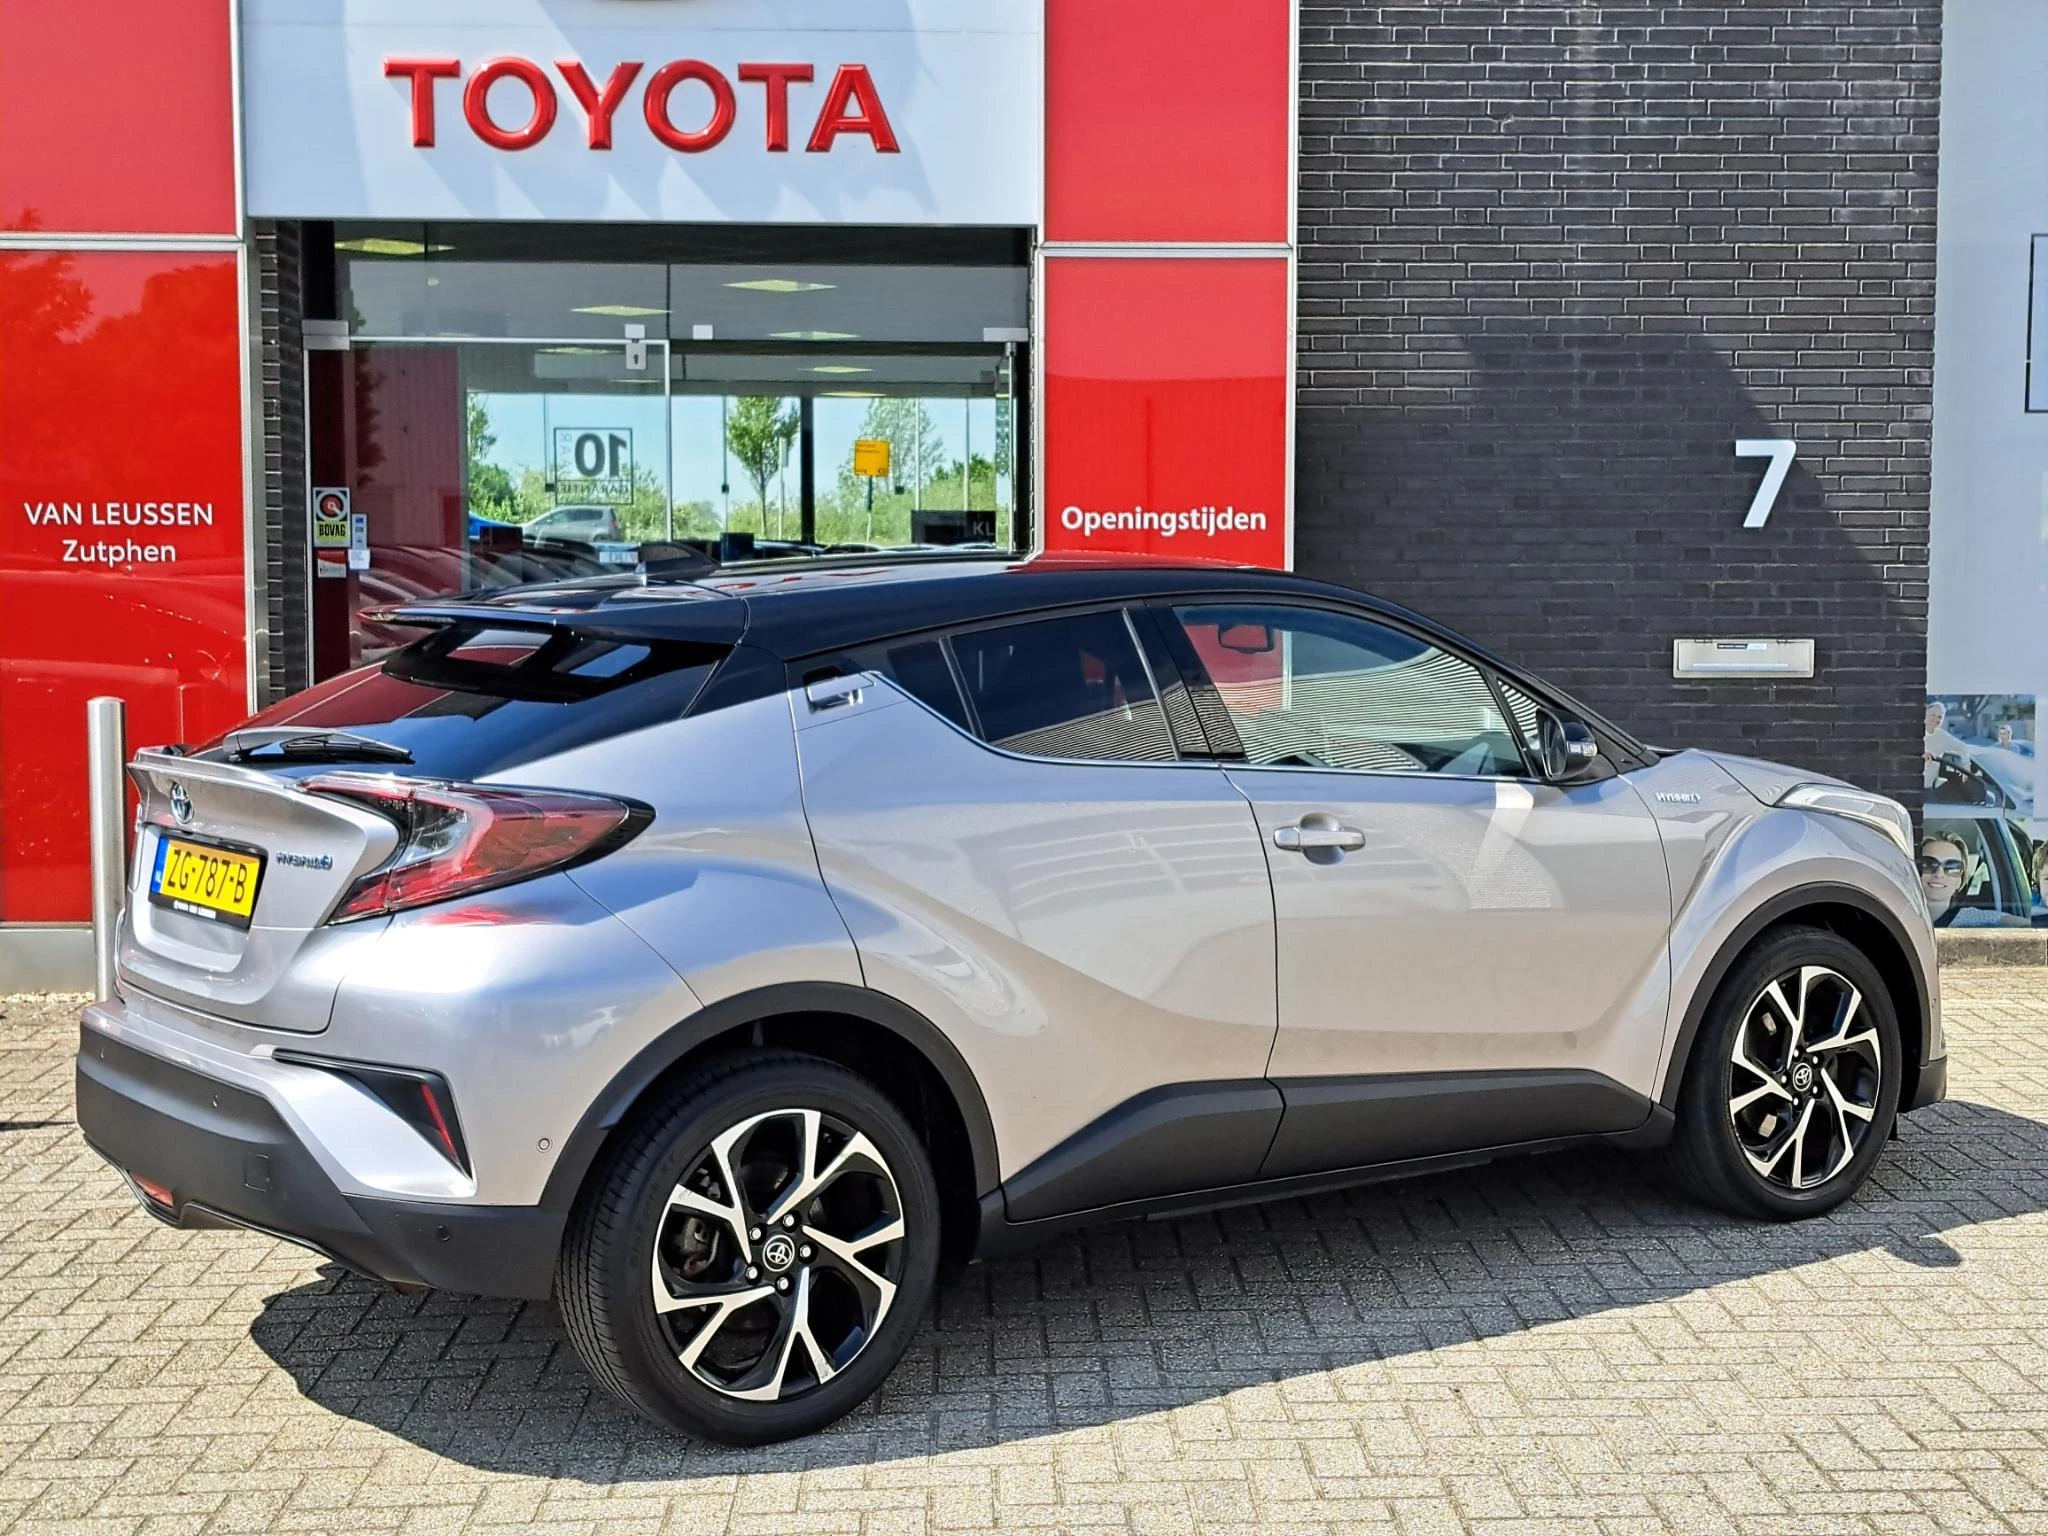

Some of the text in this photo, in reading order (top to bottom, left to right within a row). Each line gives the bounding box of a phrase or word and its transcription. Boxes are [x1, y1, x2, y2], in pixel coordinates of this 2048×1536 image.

[384, 56, 901, 153] TOYOTA
[1735, 439, 1797, 528] 7
[24, 502, 213, 526] VAN LEUSSEN
[319, 523, 346, 537] BOVAG
[1061, 505, 1267, 537] Openingstijden
[62, 538, 176, 568] Zutphen
[167, 848, 248, 905] ZG-787-B
